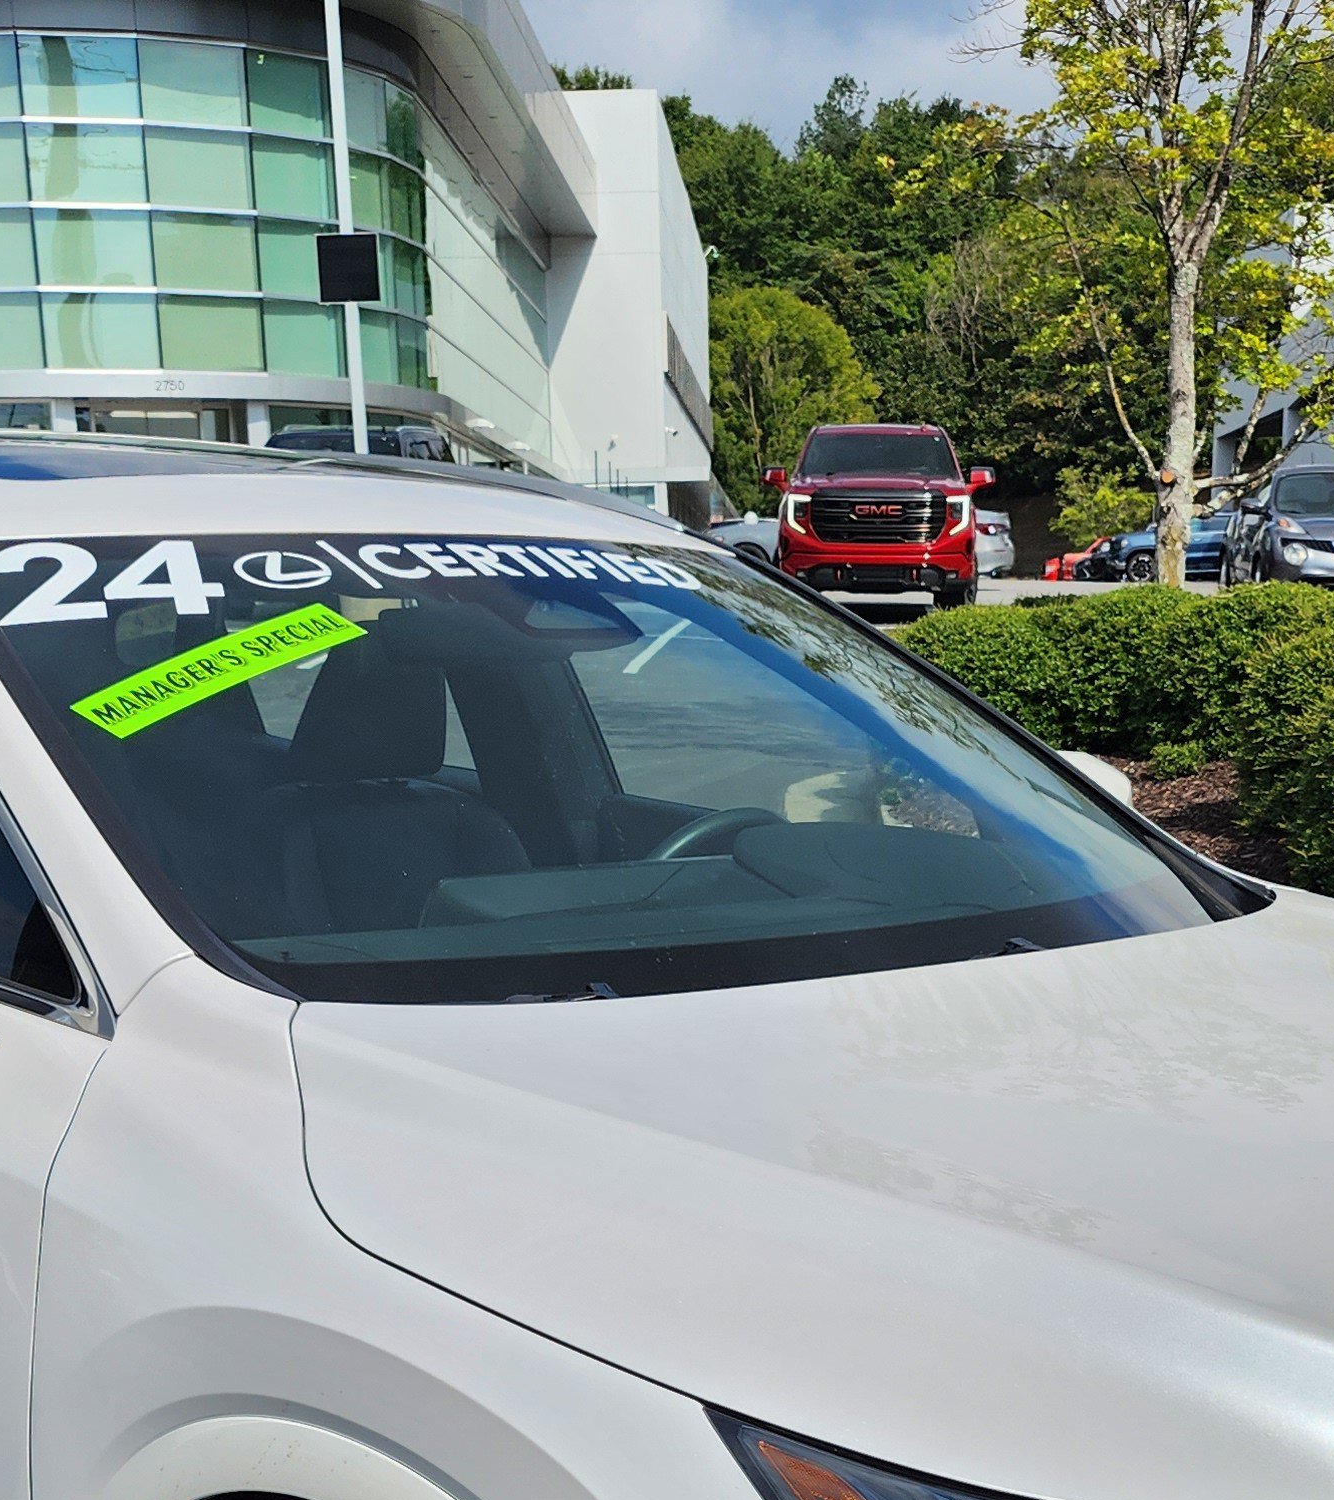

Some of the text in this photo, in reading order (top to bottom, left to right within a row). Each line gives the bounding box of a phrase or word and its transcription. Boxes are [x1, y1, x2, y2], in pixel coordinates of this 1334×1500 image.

[155, 380, 185, 392] 2750
[855, 505, 903, 515] GMC
[358, 542, 703, 591] CERTIFIED
[90, 612, 351, 727] MANAGER'S SPECIAL
